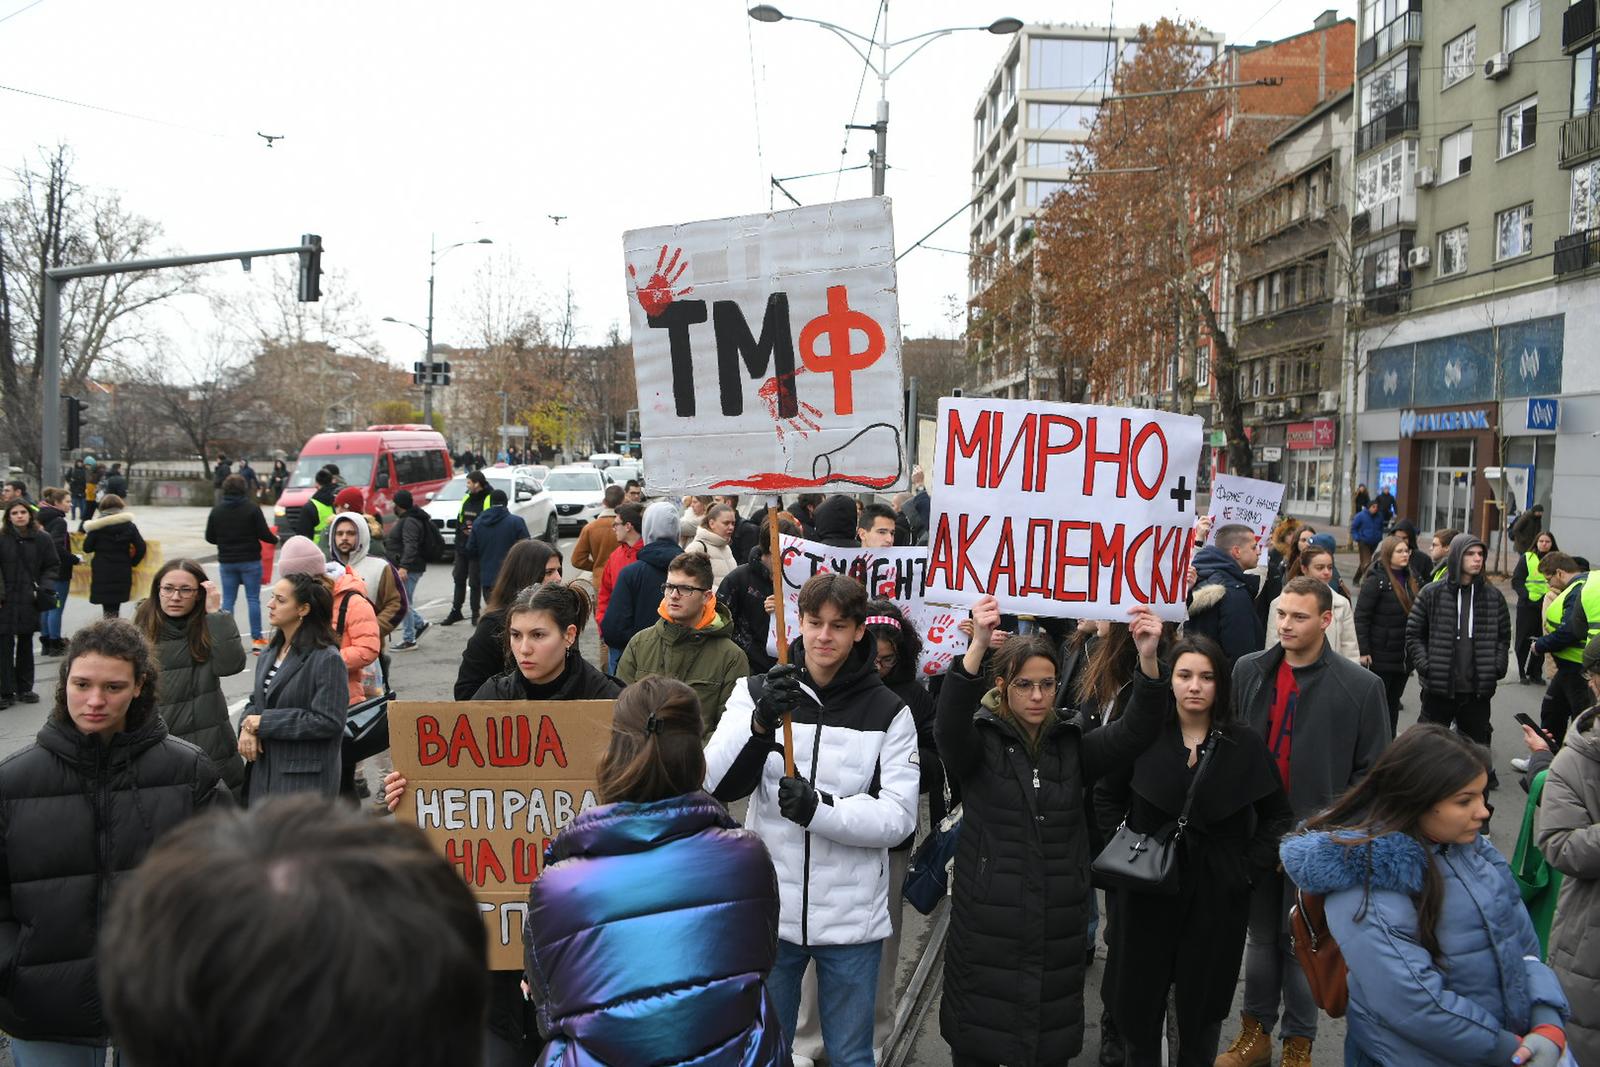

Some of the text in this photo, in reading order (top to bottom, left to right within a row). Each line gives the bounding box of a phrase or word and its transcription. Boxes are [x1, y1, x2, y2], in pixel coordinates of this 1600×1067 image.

[647, 285, 886, 418] ТМФ
[944, 409, 1168, 501] МИРНО
[416, 714, 568, 768] ВАША
